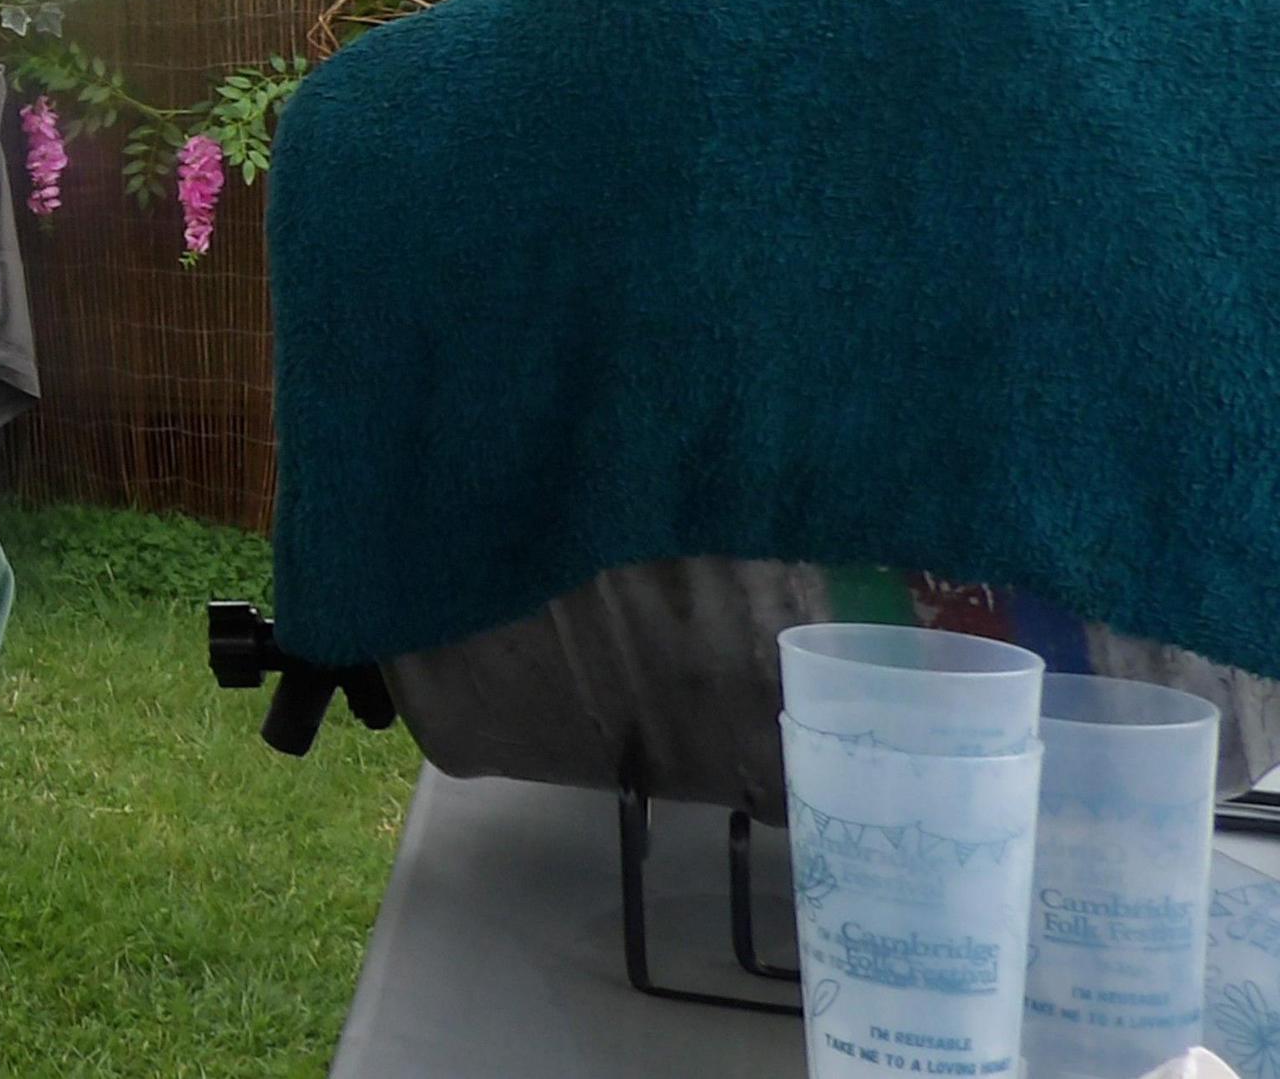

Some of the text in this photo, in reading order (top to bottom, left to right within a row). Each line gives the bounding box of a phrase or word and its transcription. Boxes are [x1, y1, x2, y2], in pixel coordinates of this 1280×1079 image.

[840, 921, 1001, 965] Cambridge
[825, 1032, 856, 1057] TAKE
[859, 1047, 880, 1065] ME
[885, 1054, 905, 1070] TO
[910, 1059, 921, 1072] A
[927, 1059, 977, 1076] LOVING
[894, 1030, 973, 1052] REUSABLE
